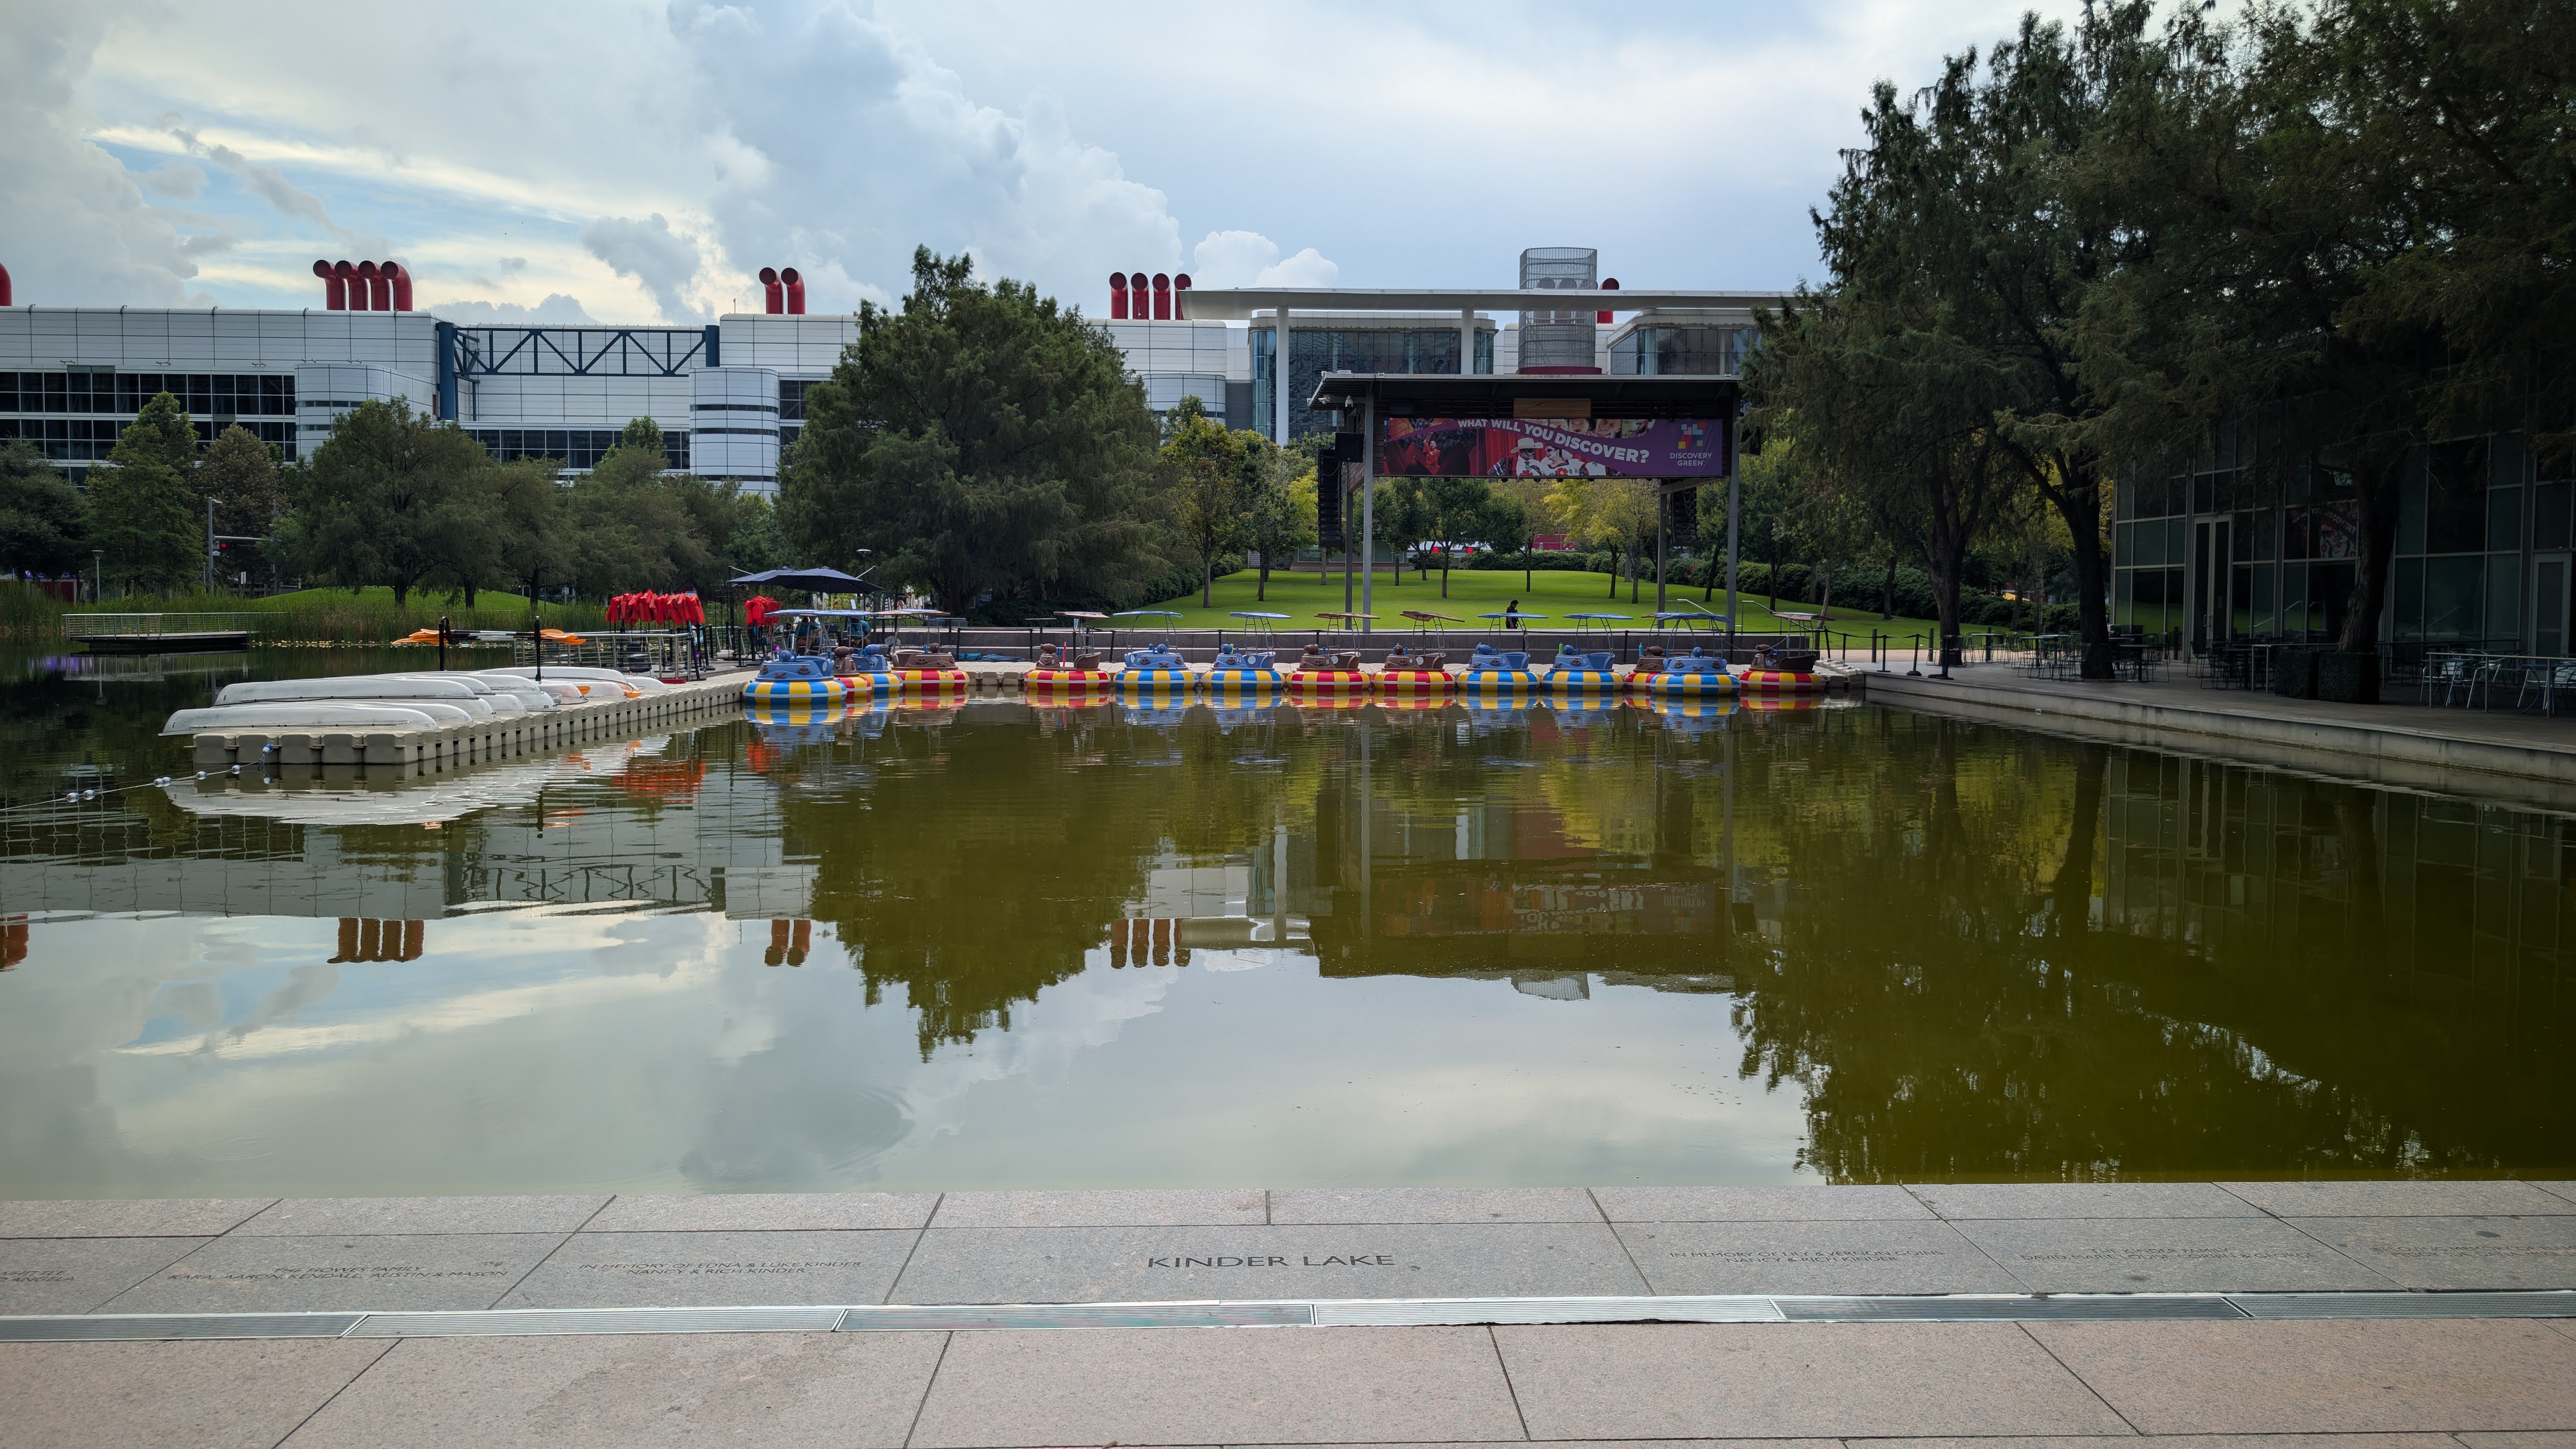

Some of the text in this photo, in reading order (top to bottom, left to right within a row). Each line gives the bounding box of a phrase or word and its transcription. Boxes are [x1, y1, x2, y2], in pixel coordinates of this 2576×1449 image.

[1458, 419, 1649, 464] WHAT WILL YOU DISCOVER?
[1148, 1255, 1395, 1268] KINDER LAKE
